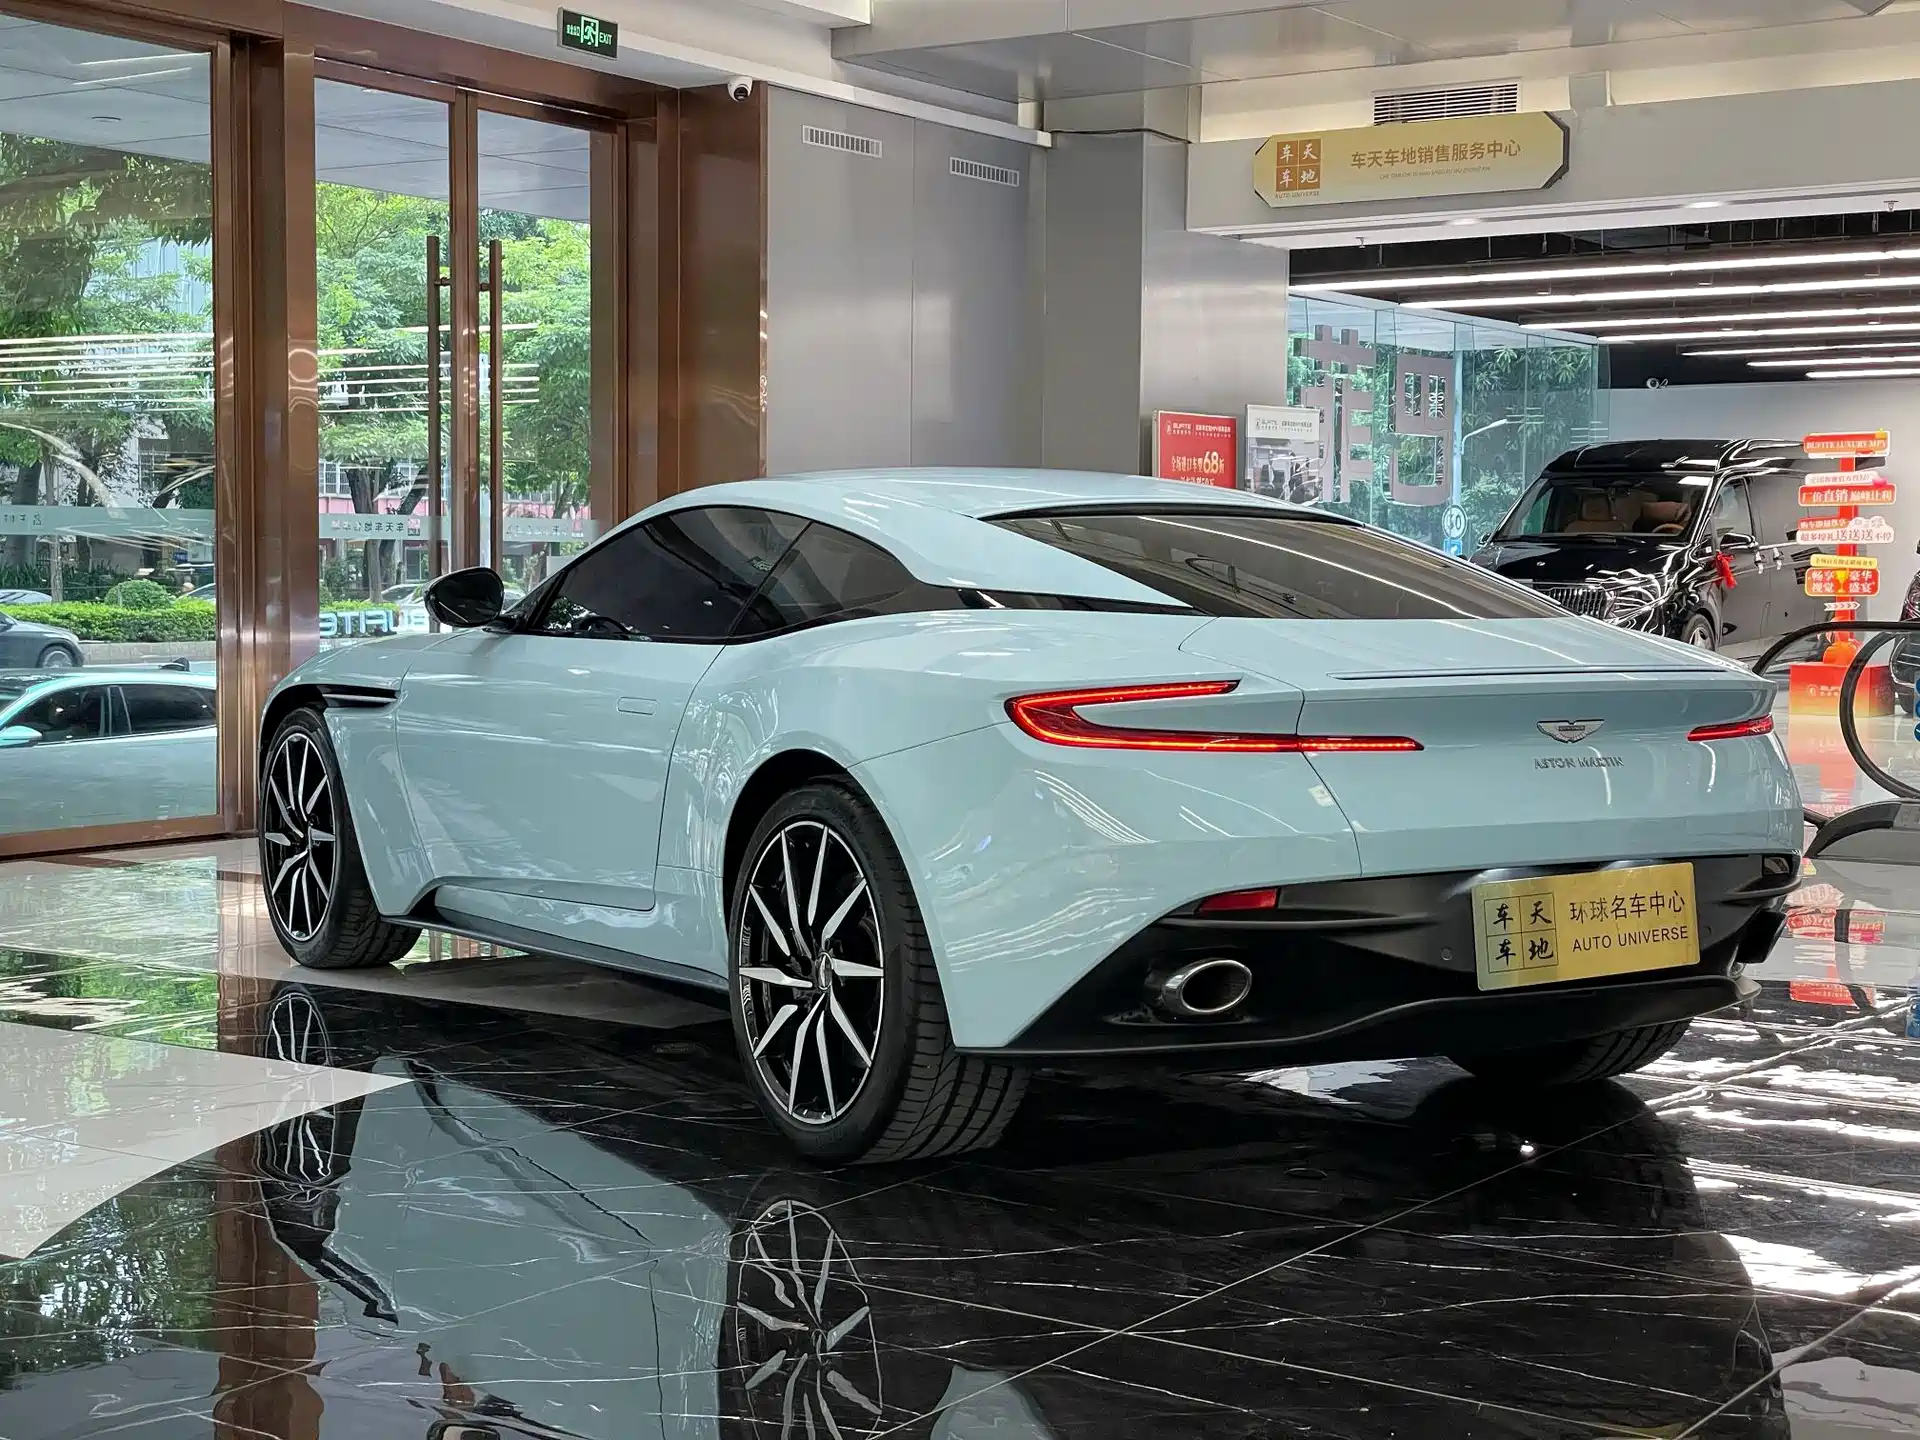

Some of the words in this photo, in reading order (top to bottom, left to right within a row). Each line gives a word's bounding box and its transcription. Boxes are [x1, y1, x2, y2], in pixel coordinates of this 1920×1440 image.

[599, 32, 612, 45] EXIT
[1350, 139, 1521, 169] 车天车地销售服务中心
[1534, 757, 1576, 769] ASTON
[1578, 756, 1624, 768] MARTIN
[1569, 890, 1685, 925] 环球名车中心
[1572, 935, 1612, 952] AUTO
[1618, 925, 1688, 947] UNIVERSE
